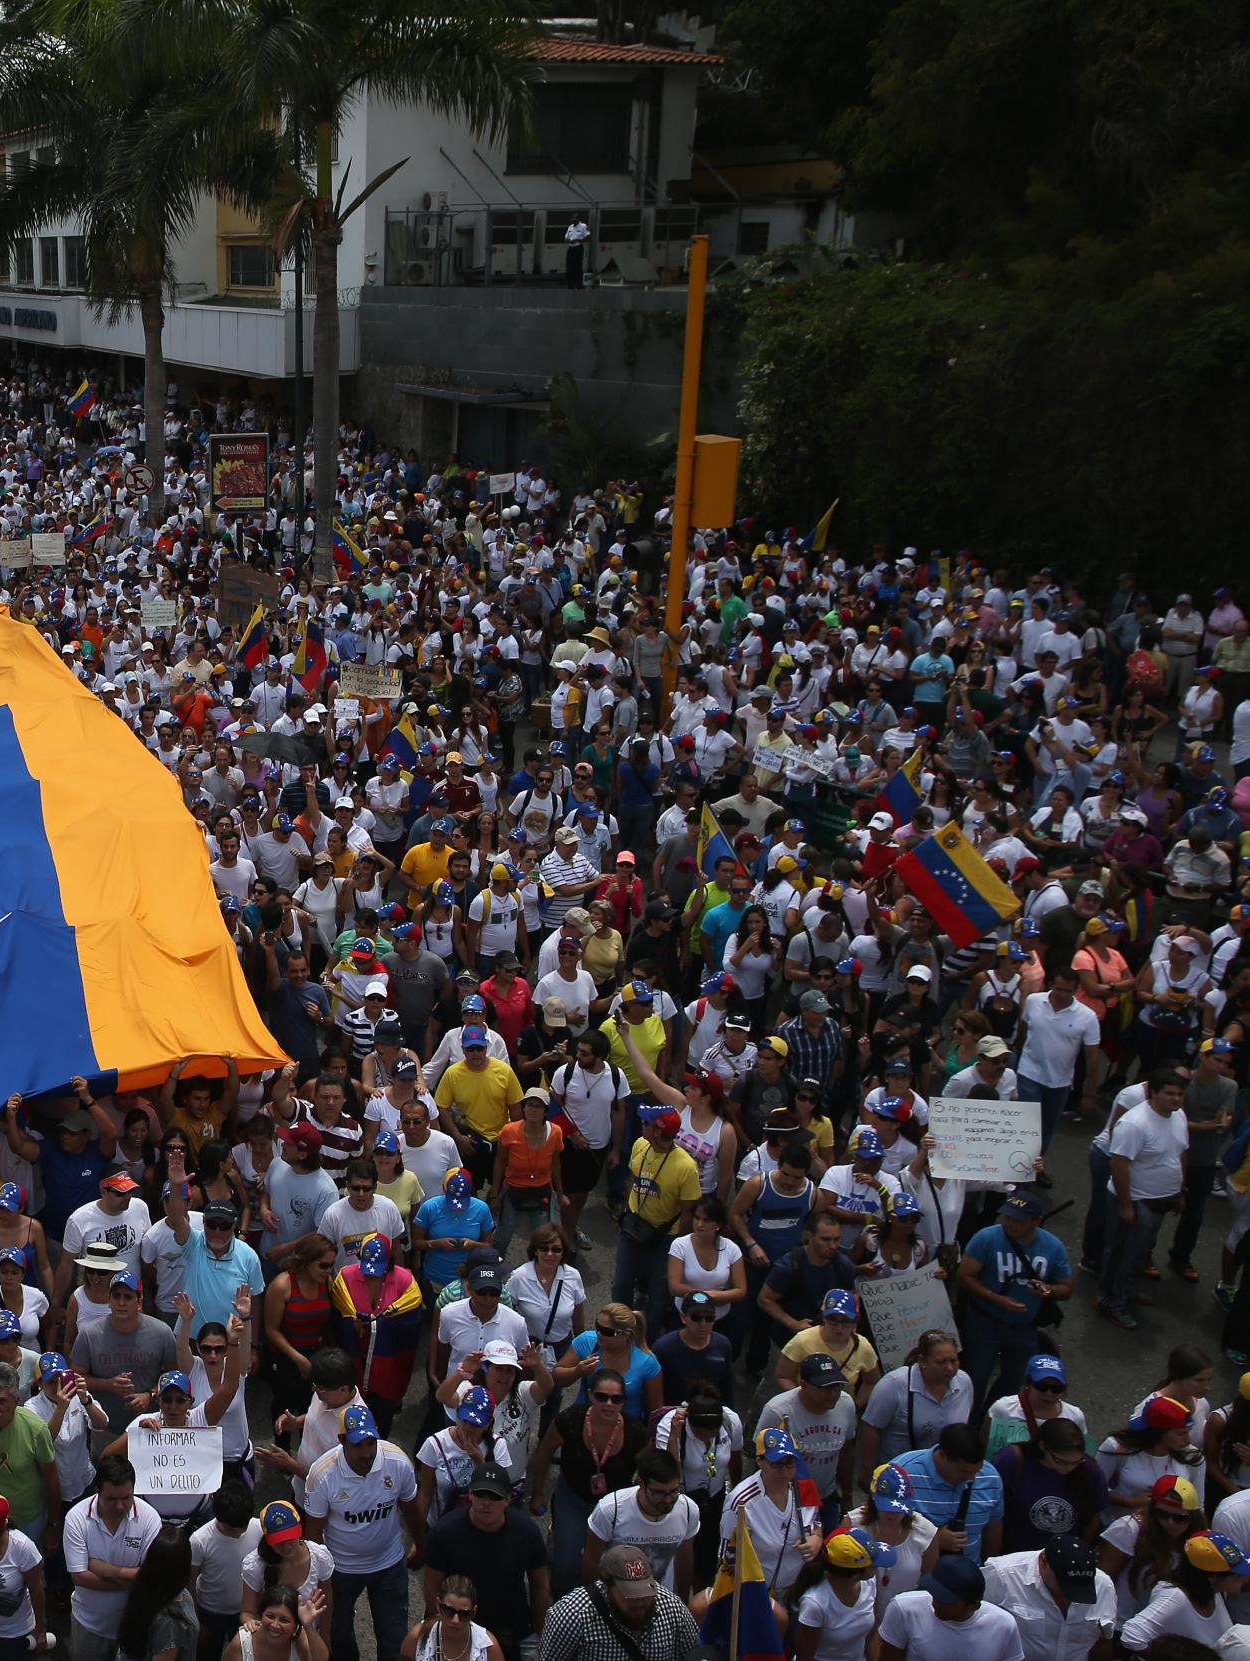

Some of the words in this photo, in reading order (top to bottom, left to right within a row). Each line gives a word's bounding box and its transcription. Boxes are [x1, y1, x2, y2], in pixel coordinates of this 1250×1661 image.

[147, 1432, 196, 1446] INFORMAR
[153, 1455, 169, 1467] NO
[173, 1455, 186, 1466] ES
[149, 1475, 163, 1489] UN
[169, 1474, 200, 1489] DELITO
[344, 1504, 394, 1525] bwin
[640, 1535, 682, 1545] MORRISON
